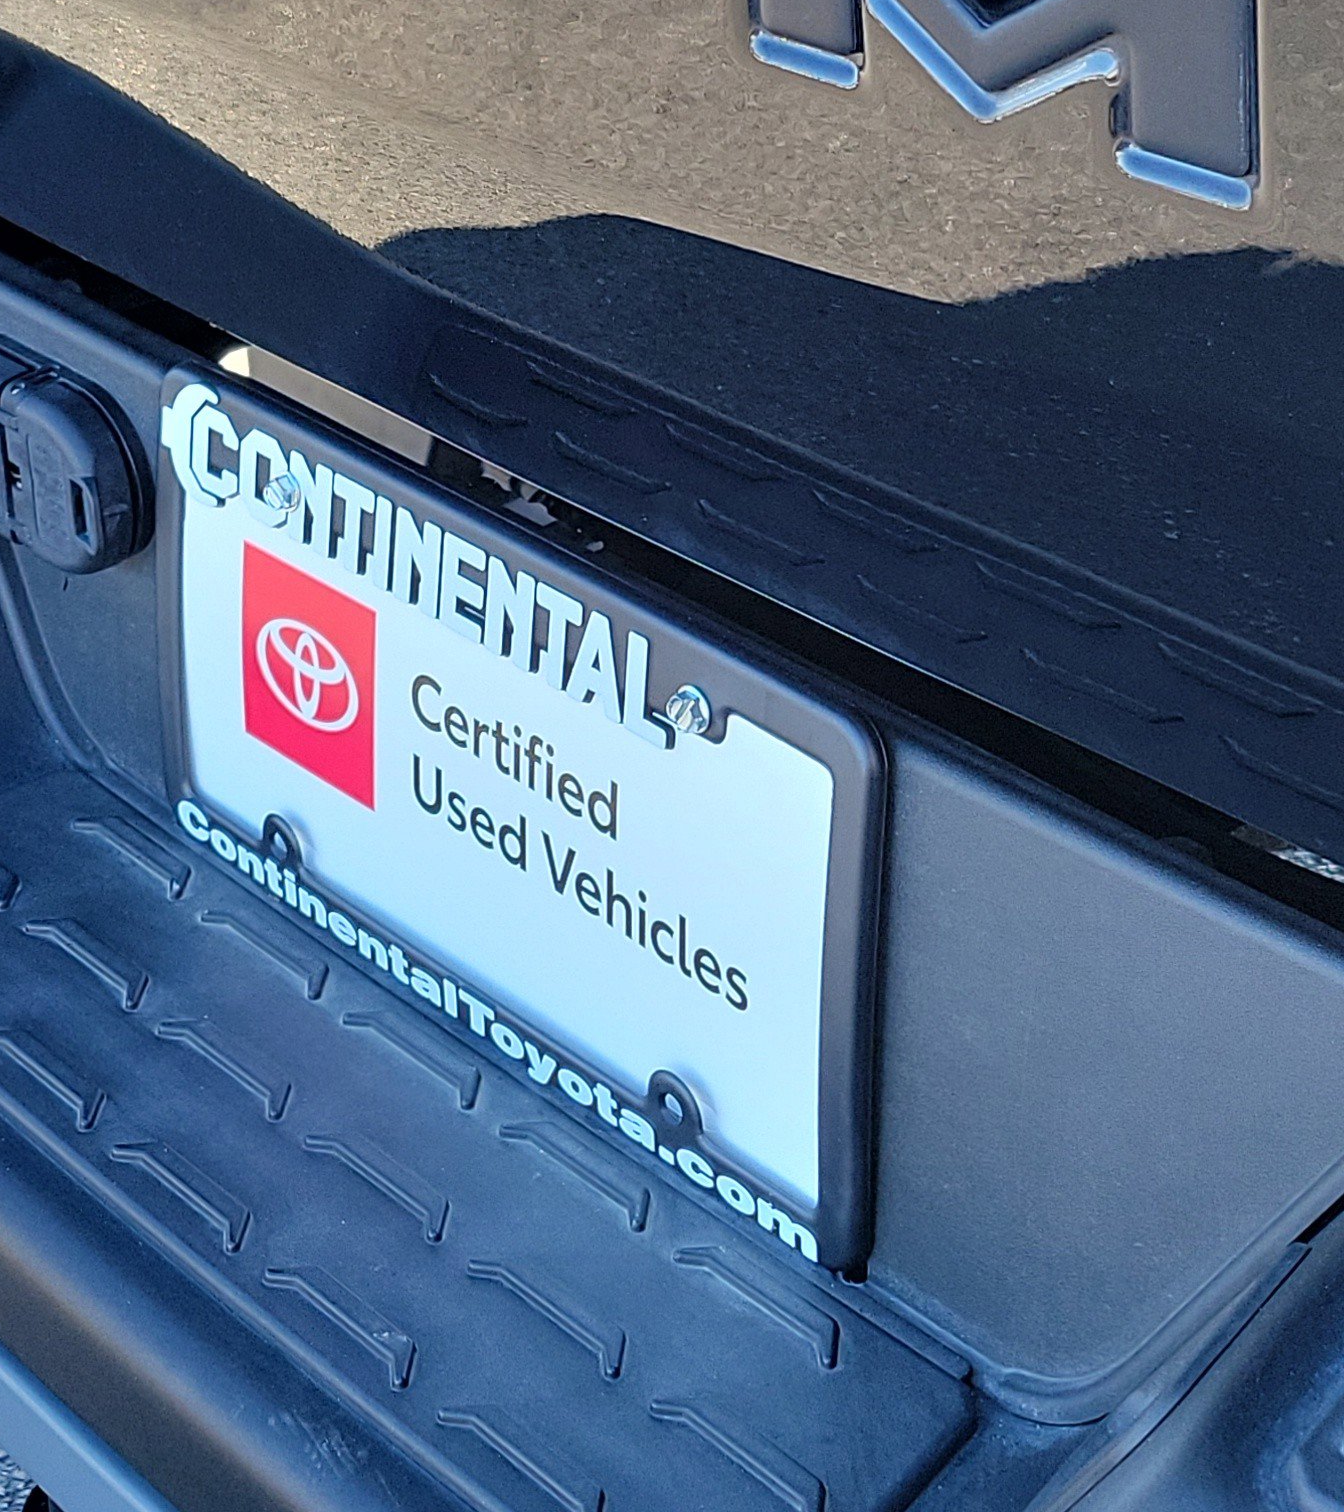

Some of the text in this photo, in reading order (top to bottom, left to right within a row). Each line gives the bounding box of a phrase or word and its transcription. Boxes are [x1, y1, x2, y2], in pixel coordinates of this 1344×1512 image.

[161, 383, 676, 750] CONTINENTAL
[411, 674, 619, 841] Certified
[412, 753, 749, 1012] Used Vehicles
[176, 799, 819, 1263] ContinentalToyota.com
